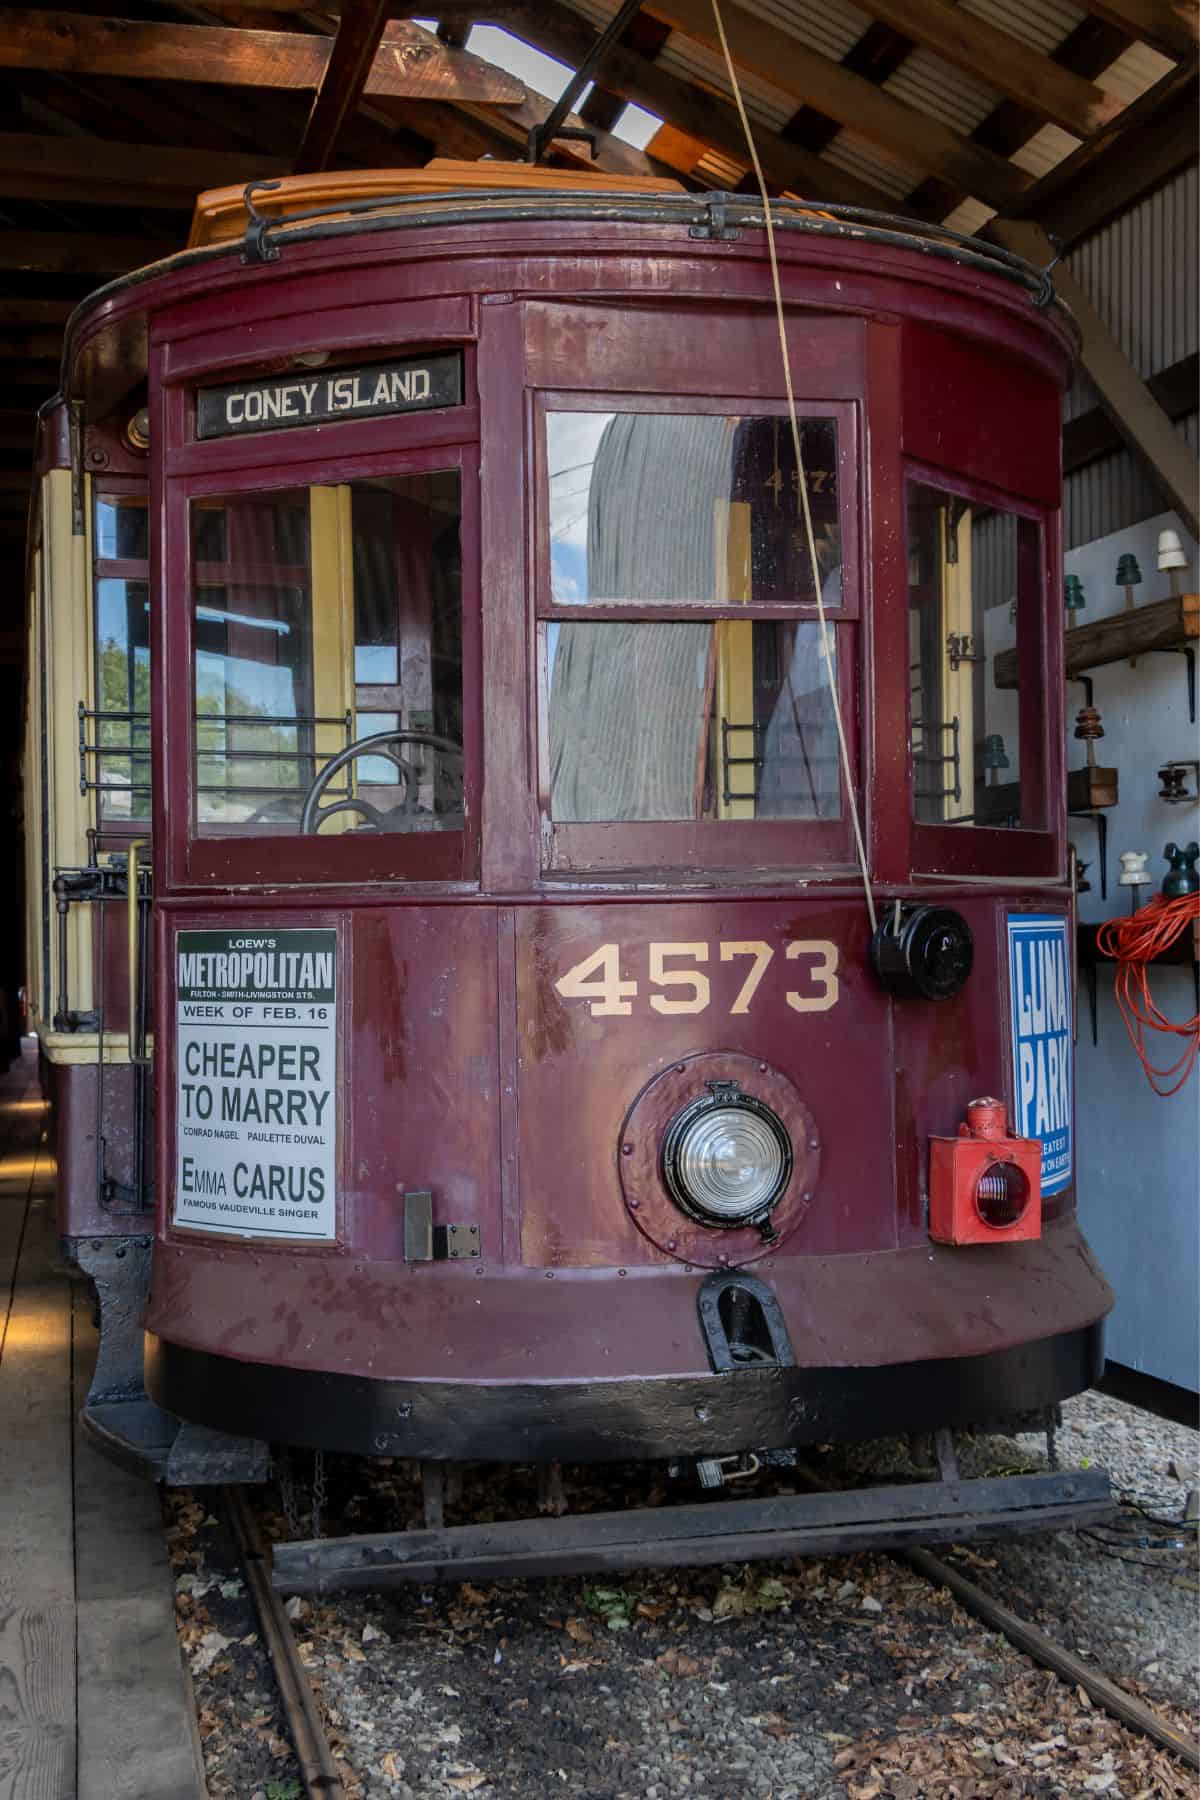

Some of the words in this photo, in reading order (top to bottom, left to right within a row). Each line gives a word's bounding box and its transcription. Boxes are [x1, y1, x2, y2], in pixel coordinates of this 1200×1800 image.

[226, 383, 318, 424] CONEY
[327, 369, 430, 412] ISLAND
[228, 938, 277, 949] LOEW'S
[178, 951, 333, 989] METROPOLITAN
[554, 940, 839, 1016] 4573
[1015, 939, 1068, 1037] LUNA
[183, 1006, 225, 1018] WEEK
[232, 1006, 254, 1019] OF
[263, 1007, 301, 1019] FEB.
[307, 1007, 328, 1020] 16
[190, 990, 217, 998] FULTON
[295, 991, 315, 1000] STS.
[185, 1041, 321, 1081] CHEAPER
[181, 1083, 213, 1120] TO
[222, 1086, 330, 1127] MARRY
[1018, 1036, 1069, 1139] PARK
[183, 1127, 213, 1138] CONRAD
[214, 1128, 240, 1140] NAGEL
[247, 1131, 291, 1144] PAULETTE
[294, 1135, 326, 1145] DUVAL
[1041, 1136, 1066, 1156] EATEST
[233, 1162, 325, 1204] CARUS
[183, 1199, 217, 1210] FAMOUS
[219, 1201, 276, 1216] VAUDEVILLE
[278, 1208, 319, 1219] SINGER
